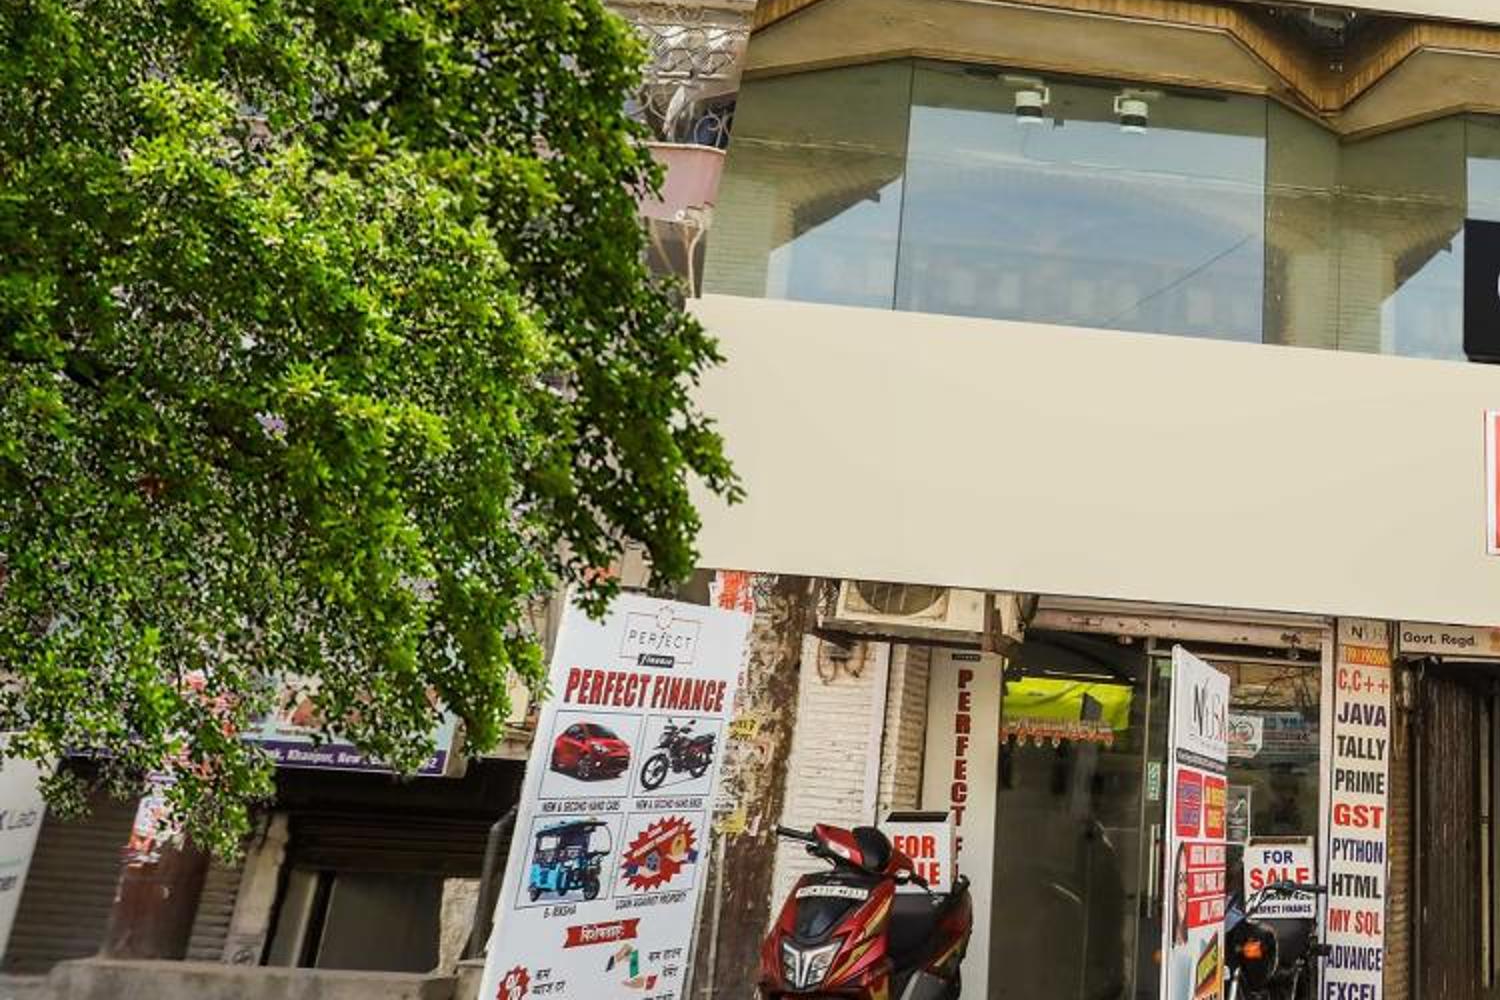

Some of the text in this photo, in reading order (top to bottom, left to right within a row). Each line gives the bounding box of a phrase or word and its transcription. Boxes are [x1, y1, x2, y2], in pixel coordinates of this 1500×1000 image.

[1402, 631, 1437, 645] Govt.
[564, 667, 727, 712] PERFECT FINANCE
[1338, 702, 1387, 728] JAVA
[951, 669, 974, 827] PERFECT
[1337, 735, 1386, 761] TALLY
[1335, 768, 1384, 794] PRIME
[1334, 803, 1384, 829] GST
[1263, 850, 1294, 864] FOR
[1332, 837, 1383, 864] PYTHON
[1331, 872, 1381, 899] HTML
[1329, 908, 1381, 937] MY SQL
[1326, 944, 1382, 971] ADVANCE
